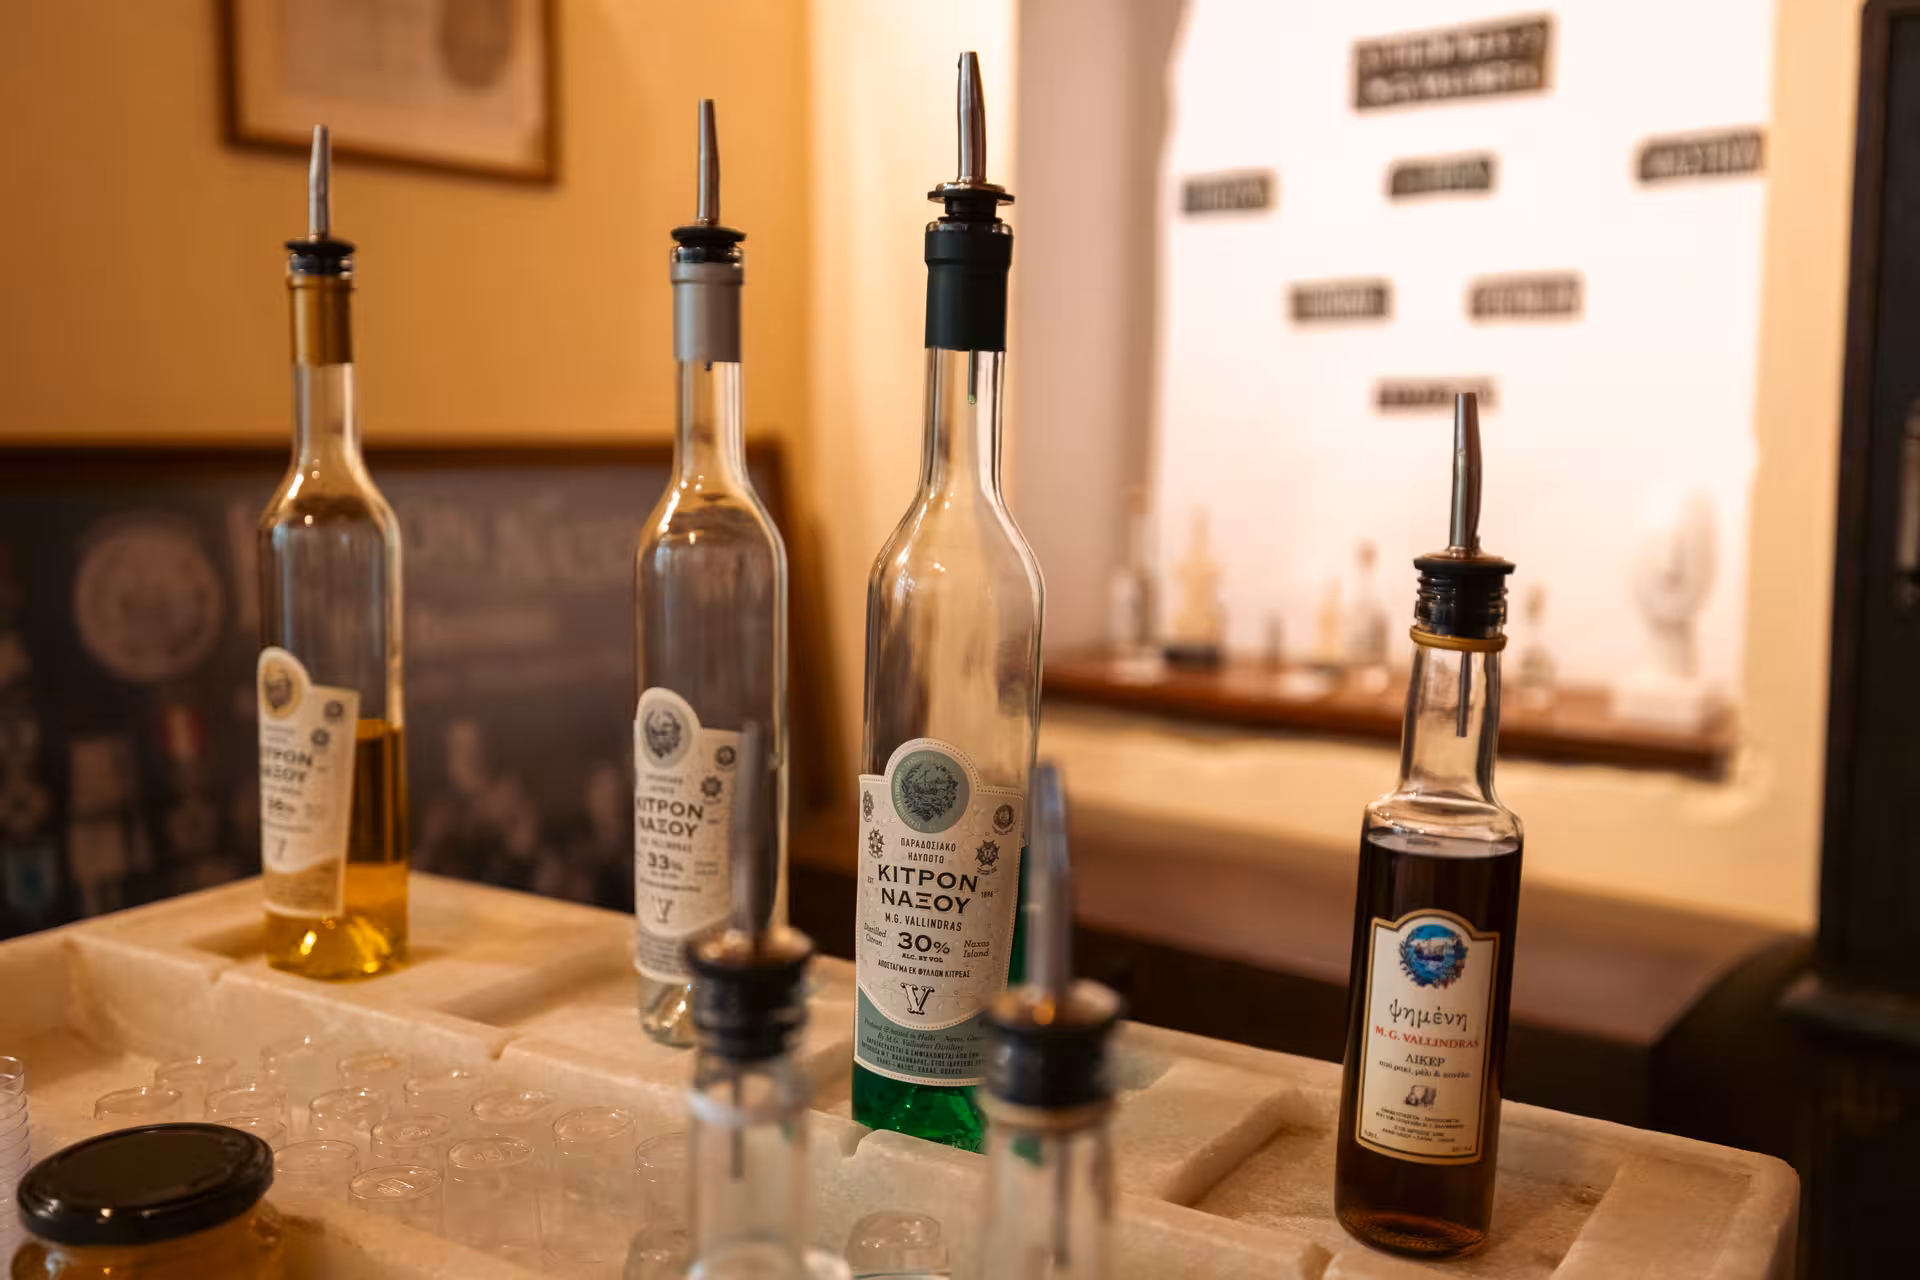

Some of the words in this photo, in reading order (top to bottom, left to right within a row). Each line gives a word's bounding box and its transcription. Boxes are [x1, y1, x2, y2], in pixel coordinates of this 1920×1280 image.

[900, 838, 957, 852] ΠΑΡΑΔΟΣΙΑΚΟ
[908, 852, 945, 864] ΗΔΥΠΟΤΟ
[878, 864, 979, 893] ΚΙΤΡΟΝ
[881, 887, 972, 914] ΝΑΞΟΥ
[863, 922, 887, 938] Distilled
[905, 915, 963, 932] VALLINDRAS
[865, 933, 883, 947] Citron
[897, 931, 950, 954] 30%
[963, 940, 990, 949] Naxos
[901, 953, 917, 961] ALC.
[962, 949, 990, 958] Island
[878, 959, 908, 974] ΑΠΟΣΤΑΓΜΑ
[909, 966, 917, 974] ΕΚ
[918, 968, 944, 978] ΦΥΛΛΩΝ
[944, 970, 971, 978] ΚΙΤΡΕΑΣ
[900, 982, 935, 1015] V
[1389, 999, 1468, 1032] ψημένη
[1402, 1033, 1479, 1049] VALLINDRAS
[1405, 1053, 1446, 1067] ΛΙΚΕΡ
